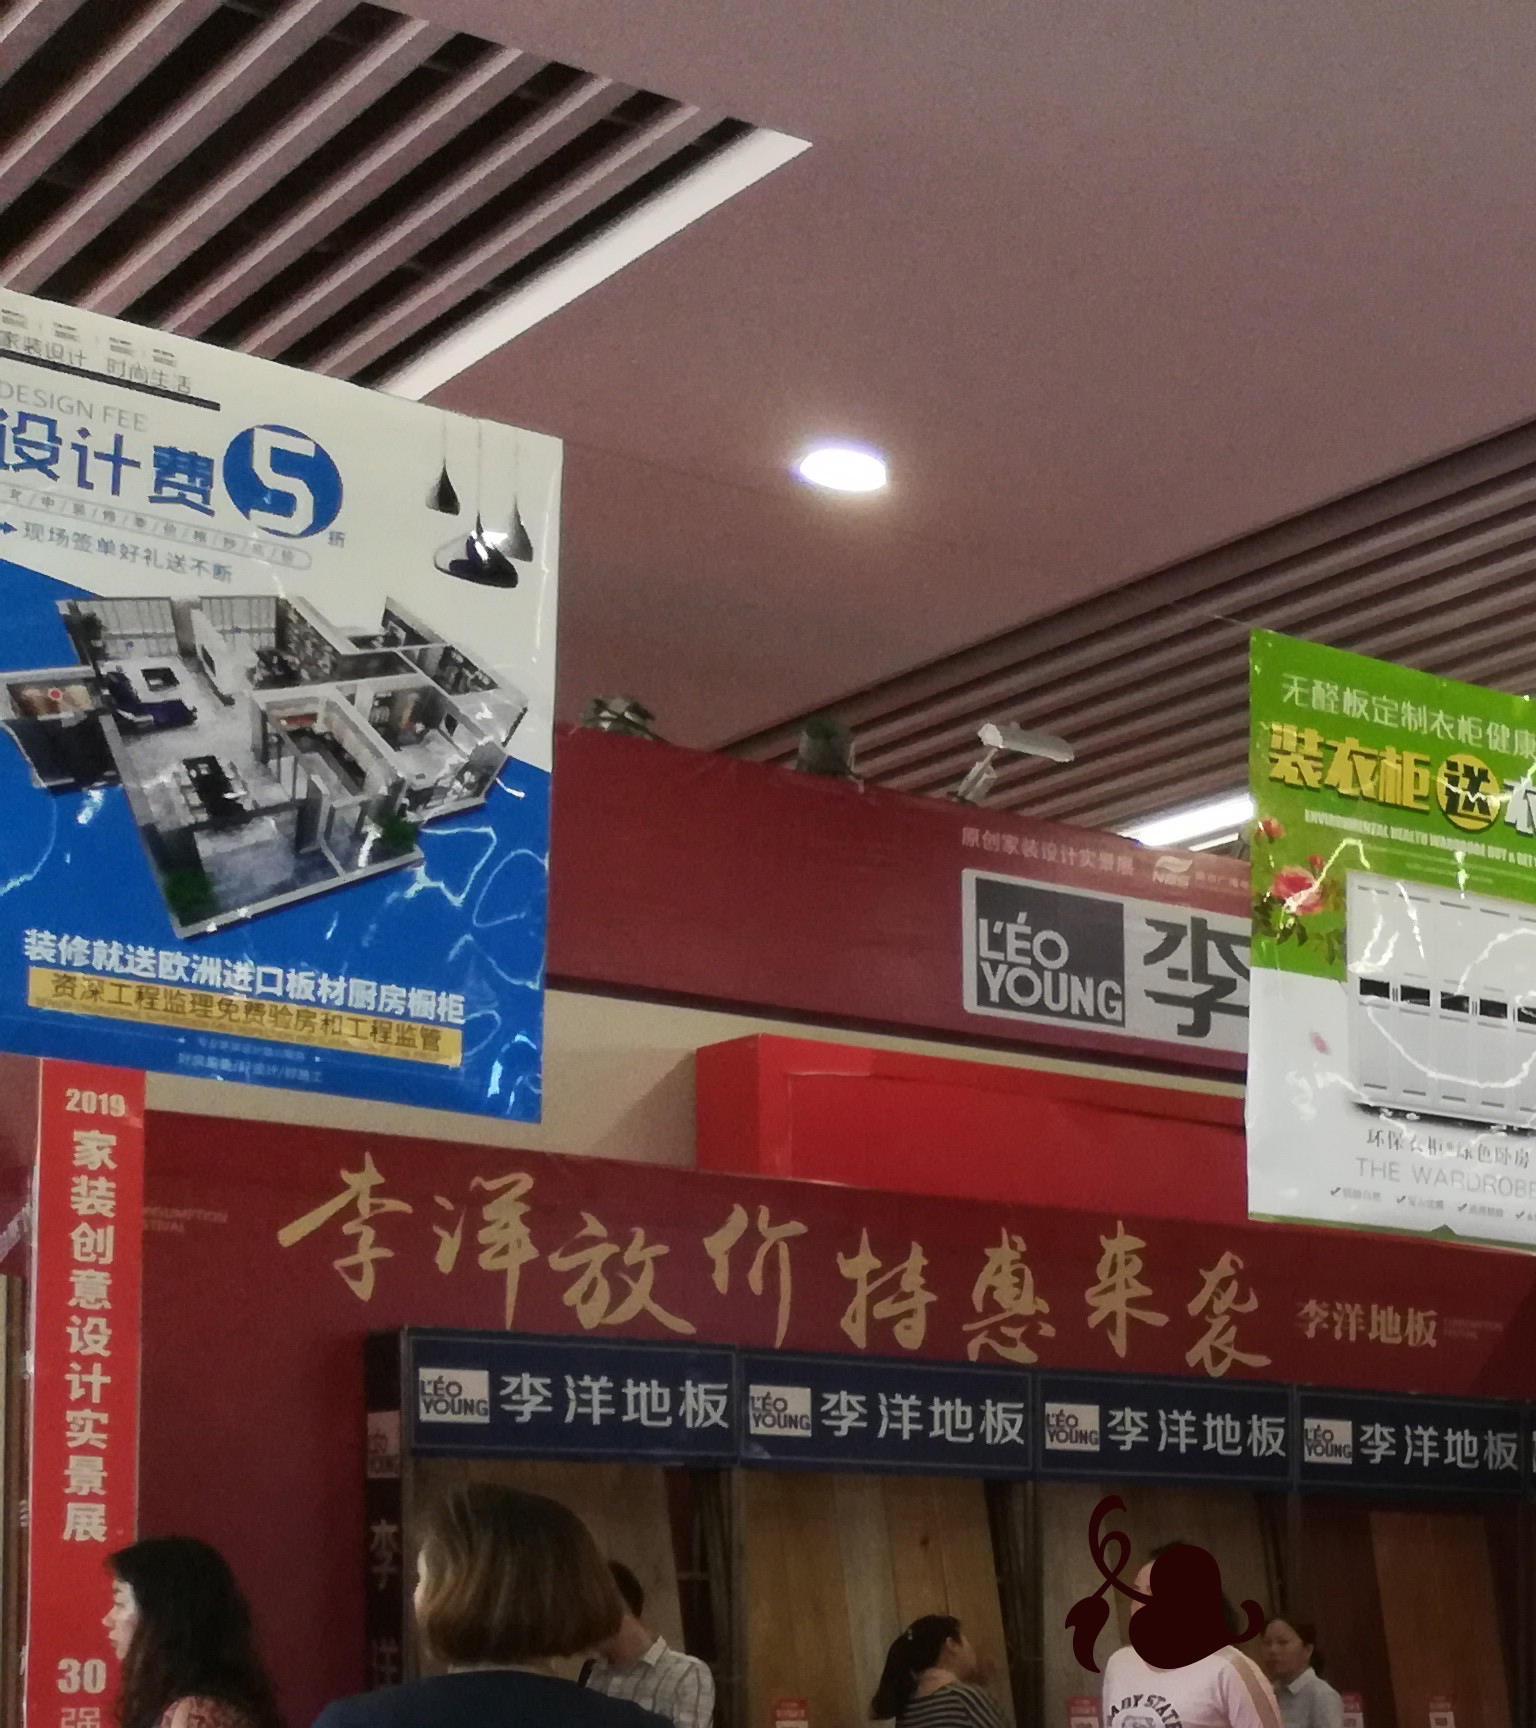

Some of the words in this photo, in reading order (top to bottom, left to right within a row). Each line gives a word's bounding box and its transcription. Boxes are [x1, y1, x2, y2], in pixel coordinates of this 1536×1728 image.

[102, 405, 148, 432] FEE
[0, 408, 216, 517] 设计费
[980, 960, 1123, 1021] YOUNG
[65, 1088, 127, 1118] 2019
[1355, 1157, 1401, 1183] THE
[61, 1129, 118, 1545] 家装创意设计实景展
[1296, 1298, 1438, 1348] 李洋地板
[420, 1398, 489, 1417] YOUNG
[499, 1371, 731, 1430] 李洋地板
[752, 1412, 811, 1431] YOUNG
[819, 1389, 1025, 1445] 李洋地板
[1107, 1406, 1287, 1457] 李洋地板
[1358, 1423, 1519, 1471] 李洋地板
[57, 1658, 107, 1694] 30
